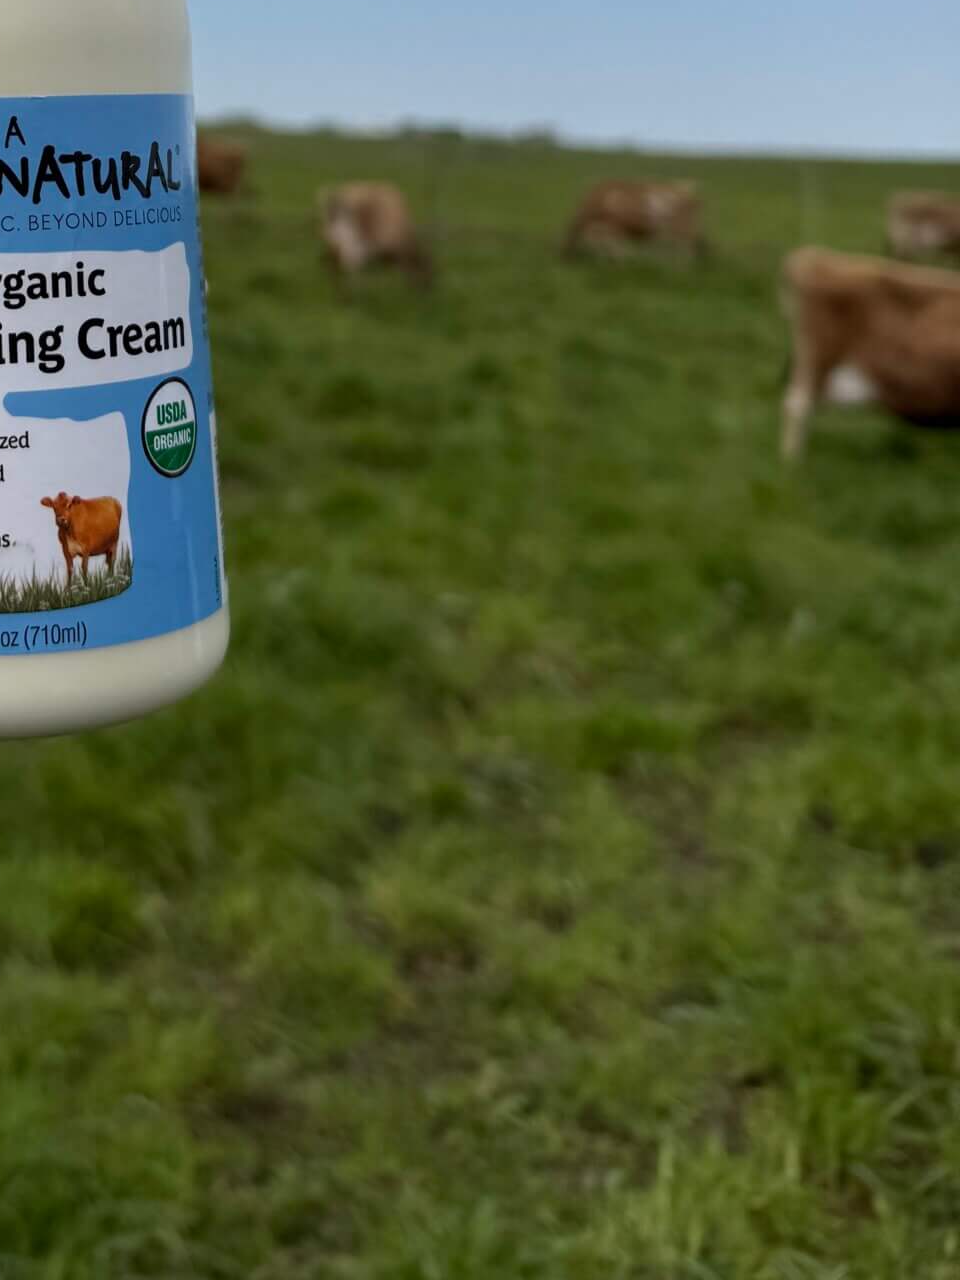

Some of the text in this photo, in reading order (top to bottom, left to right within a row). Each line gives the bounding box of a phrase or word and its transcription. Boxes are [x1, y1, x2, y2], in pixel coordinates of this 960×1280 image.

[28, 211, 108, 232] BEYOND
[77, 315, 186, 361] Cream
[155, 399, 188, 426] USDA
[152, 426, 192, 452] ORGANIC
[0, 630, 20, 648] oz
[24, 621, 88, 651] (710ml)
